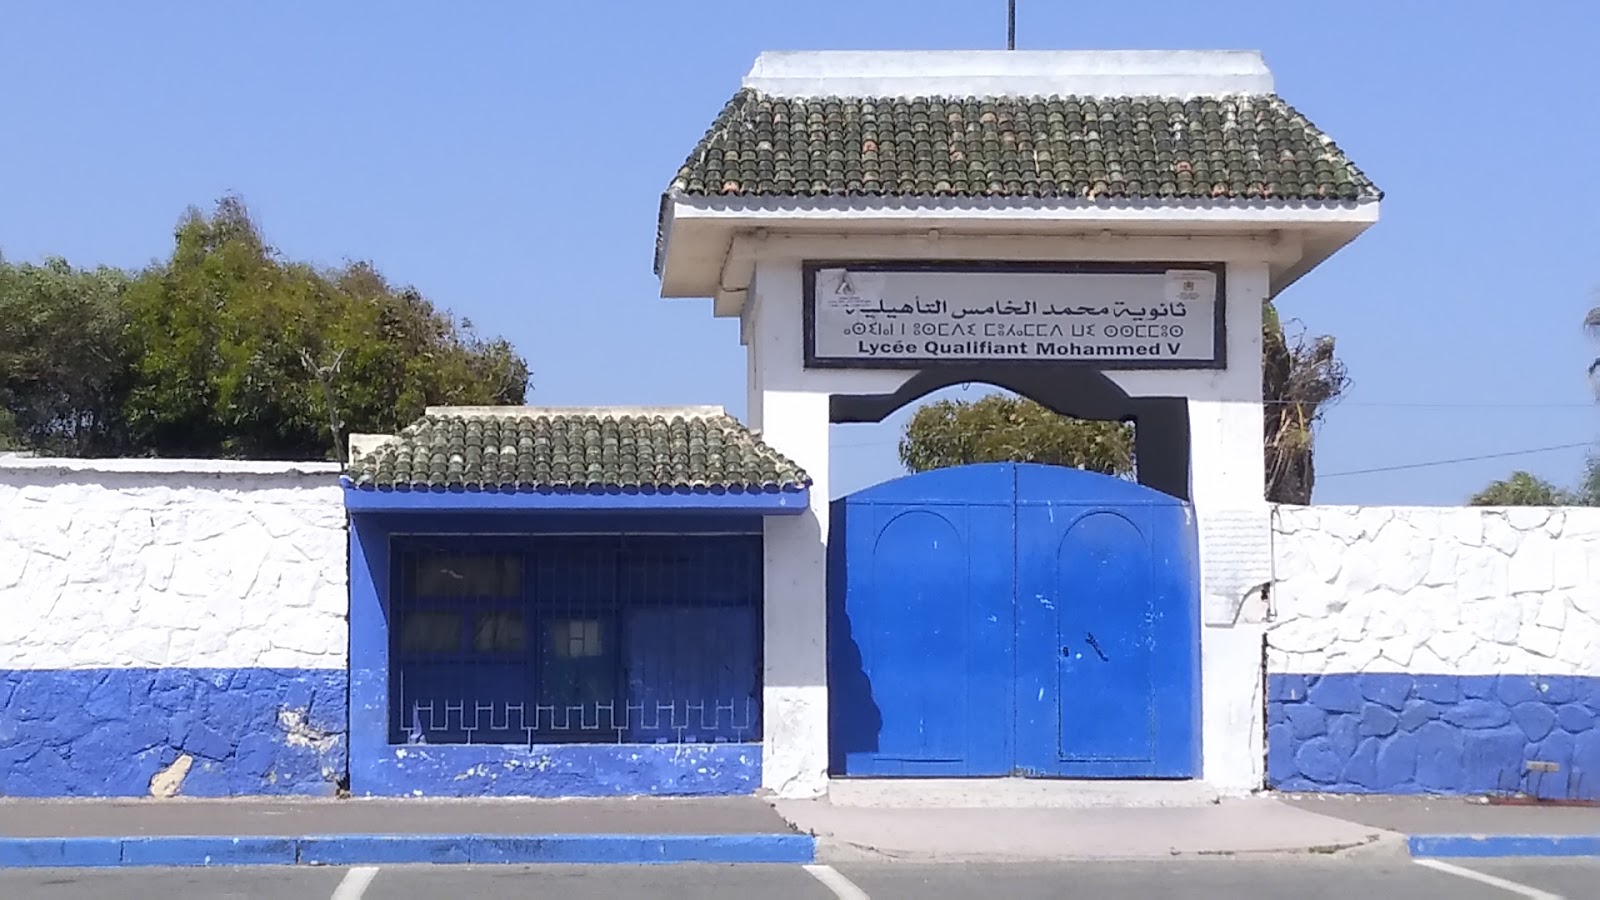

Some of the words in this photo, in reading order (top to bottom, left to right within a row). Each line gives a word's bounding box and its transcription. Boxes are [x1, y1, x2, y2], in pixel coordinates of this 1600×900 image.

[951, 300, 1037, 319] الخامس
[1042, 304, 1109, 316] محمد
[1113, 301, 1187, 321] ثانوية
[858, 340, 917, 356] Lycée
[924, 341, 1028, 356] Qualifiant
[1036, 342, 1161, 356] Mohammed
[1166, 342, 1181, 356] V
